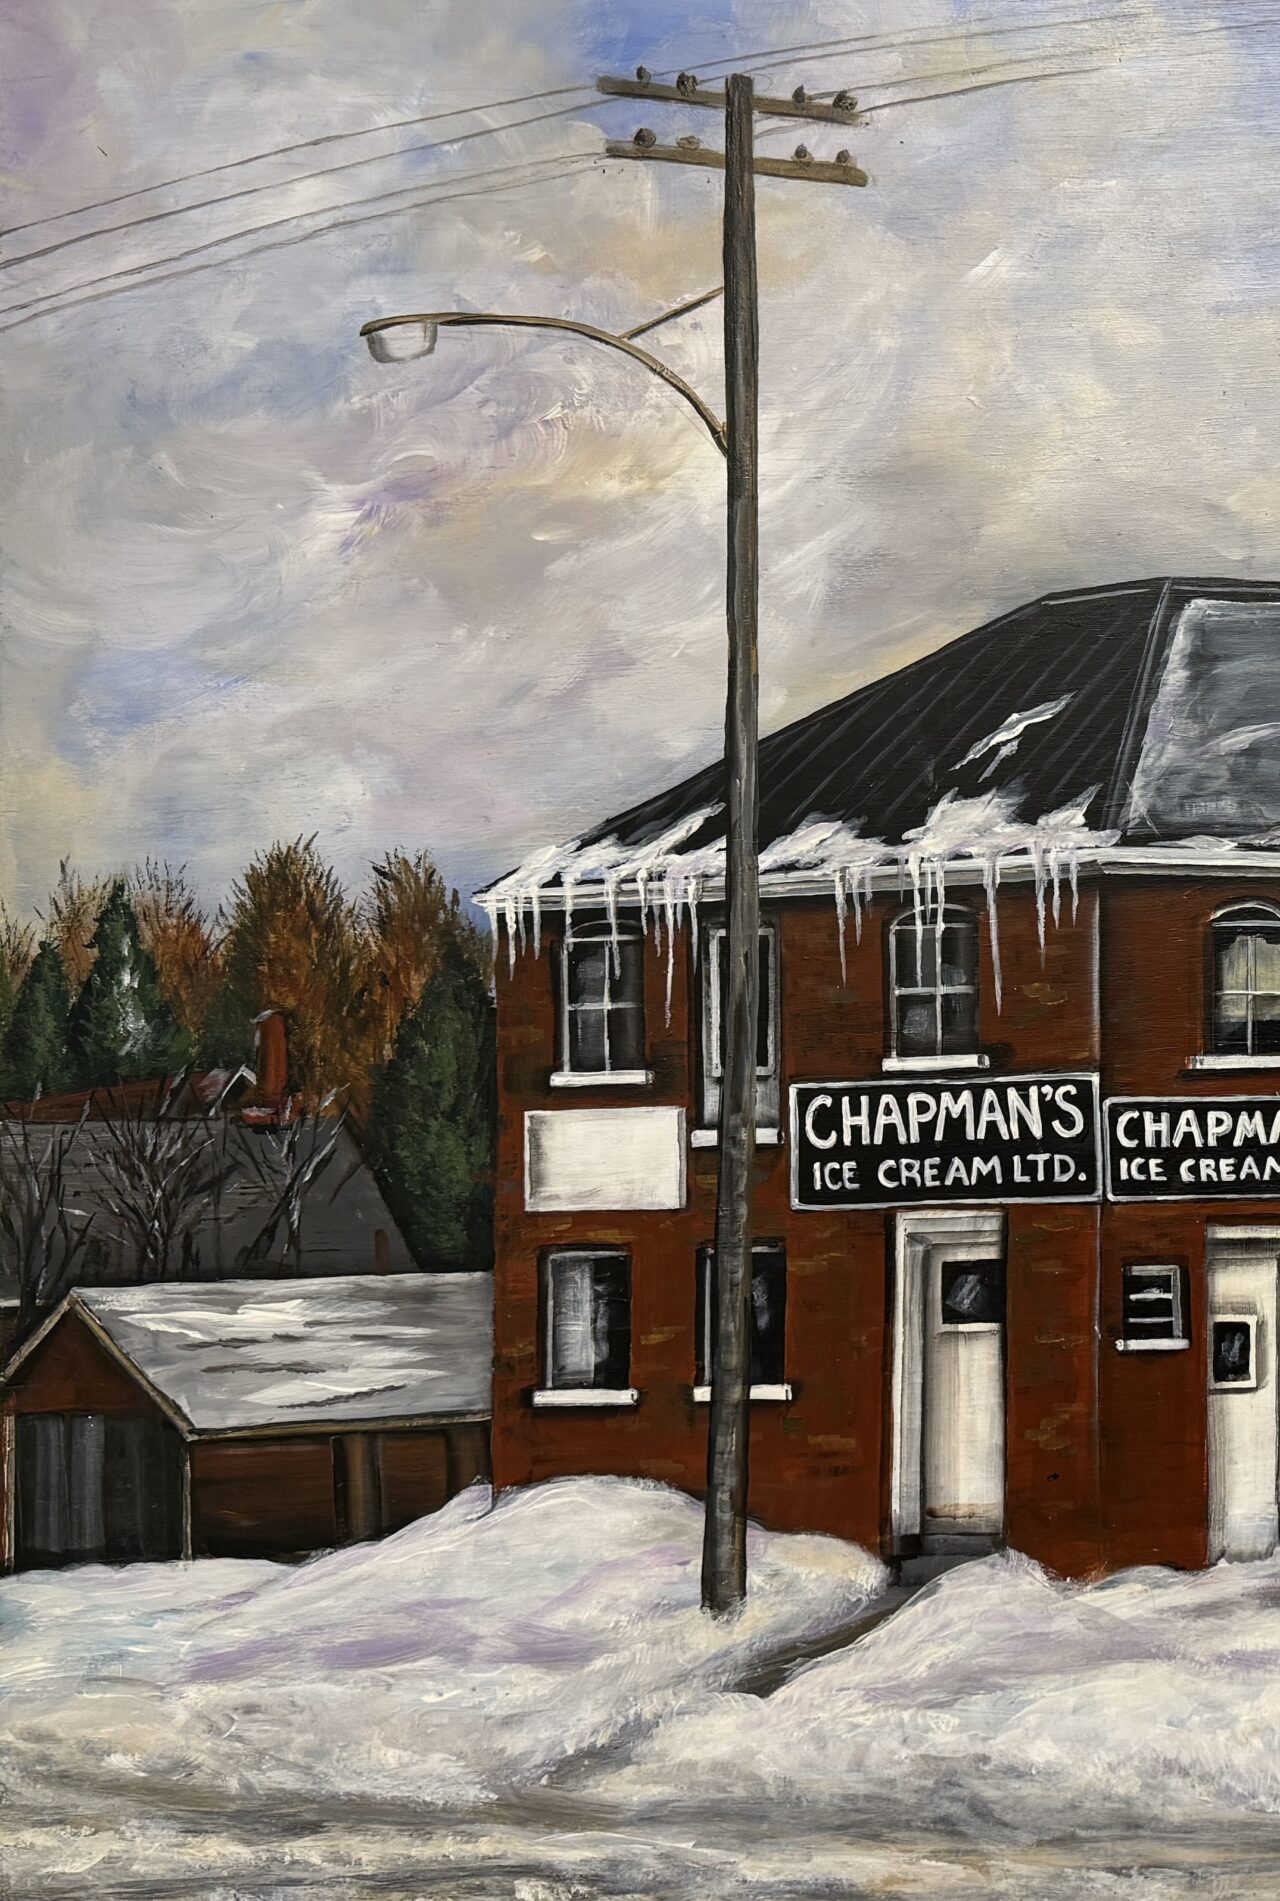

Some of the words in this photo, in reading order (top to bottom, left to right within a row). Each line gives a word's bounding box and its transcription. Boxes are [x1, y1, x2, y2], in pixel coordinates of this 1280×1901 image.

[804, 1084, 1085, 1149] CHAPMAN'S
[812, 1161, 861, 1191] ICE
[877, 1155, 1004, 1189] CREAM
[1012, 1152, 1087, 1183] LTD.
[1118, 1157, 1169, 1182] ICE
